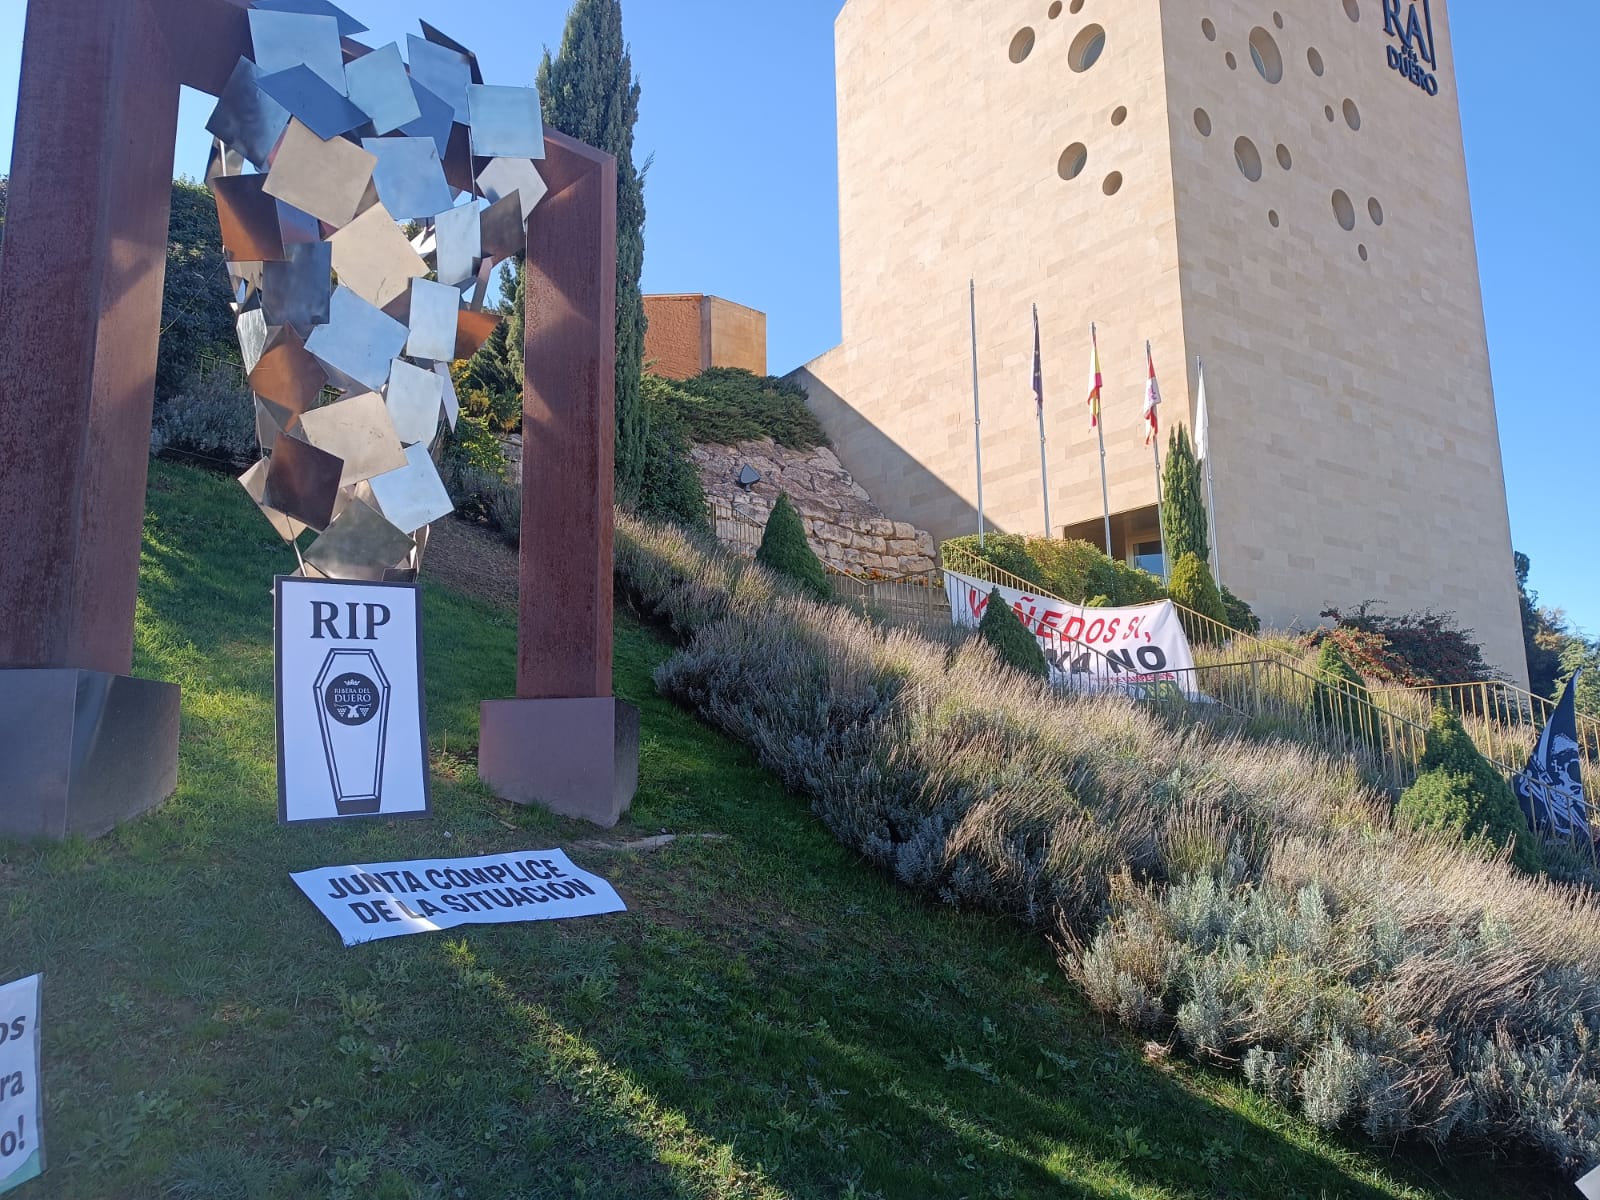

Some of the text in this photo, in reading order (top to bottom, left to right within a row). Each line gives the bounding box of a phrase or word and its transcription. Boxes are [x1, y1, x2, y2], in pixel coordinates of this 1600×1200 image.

[1386, 44, 1438, 96] DUERO
[310, 600, 391, 640] RIP
[969, 589, 1120, 643] VÑEDOS
[1106, 645, 1167, 673] NO
[334, 694, 371, 703] DUERO
[328, 859, 568, 899] JUNTA CÓMPLICE
[347, 878, 596, 924] DE LA SITUACIÓN
